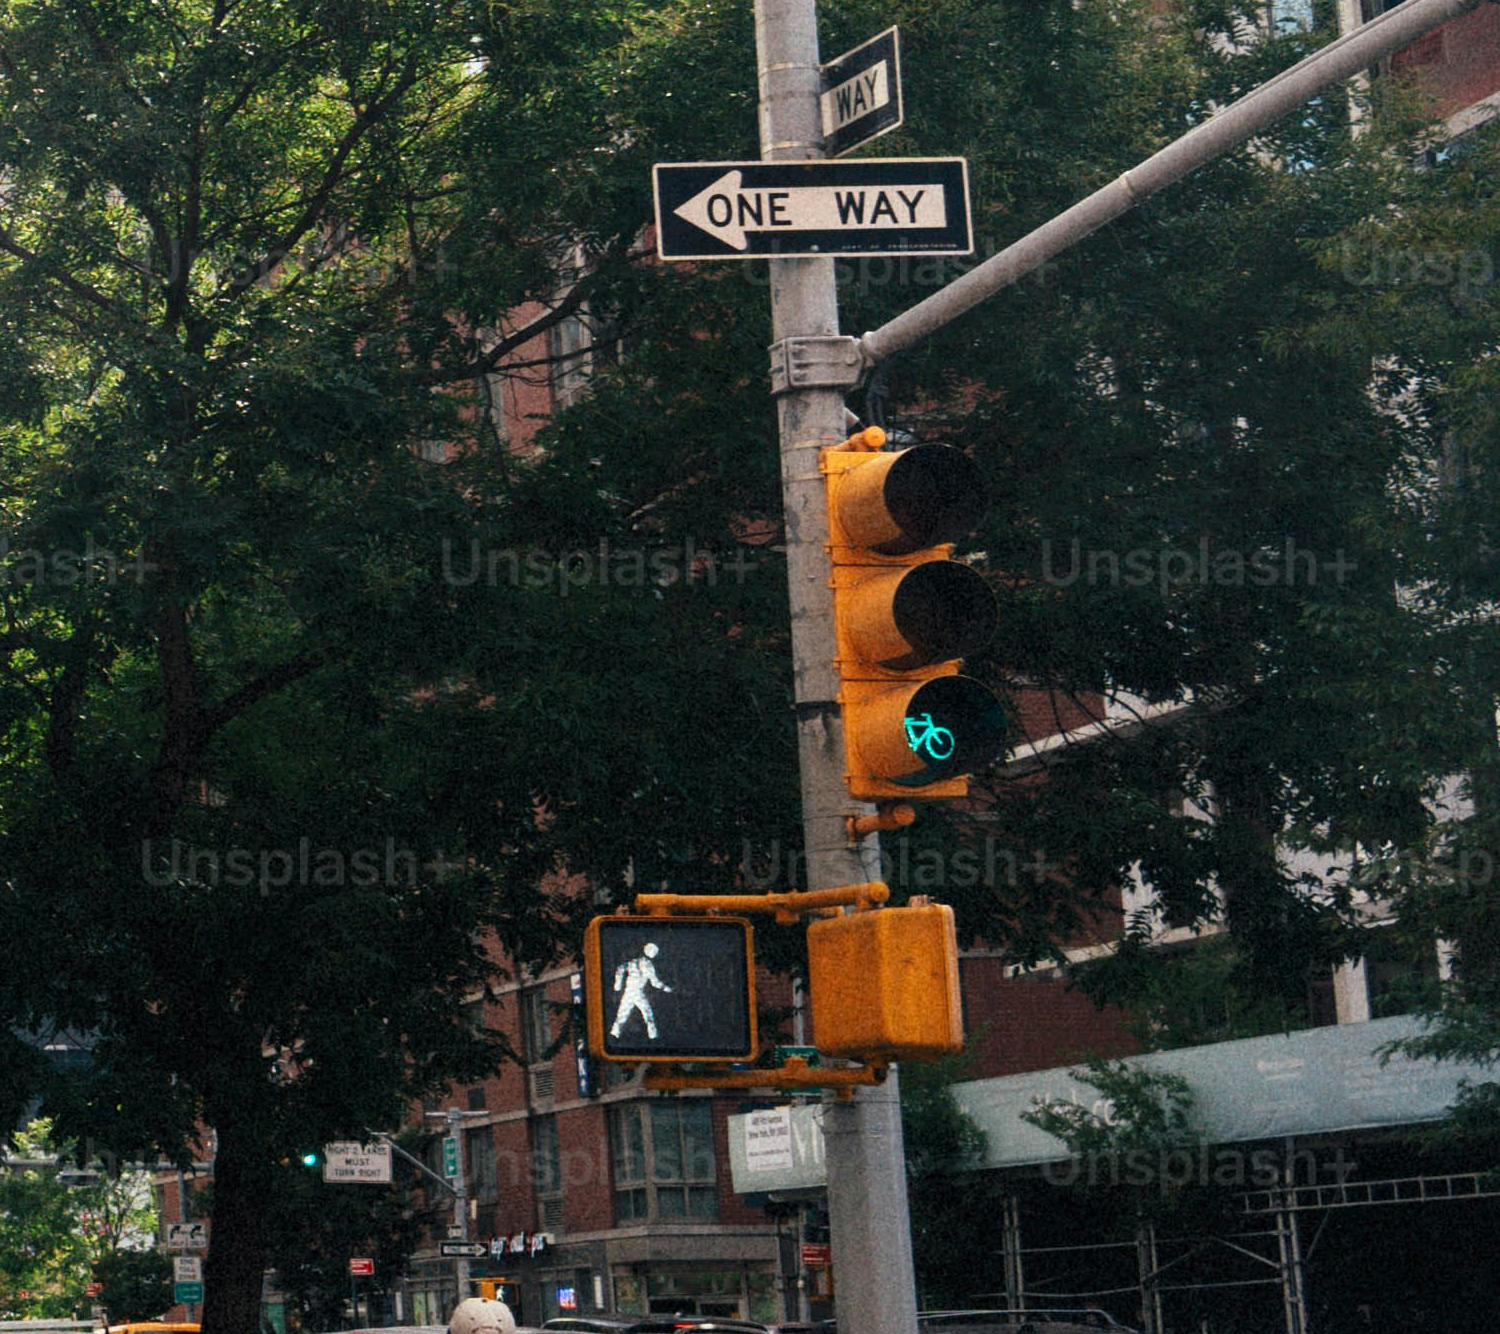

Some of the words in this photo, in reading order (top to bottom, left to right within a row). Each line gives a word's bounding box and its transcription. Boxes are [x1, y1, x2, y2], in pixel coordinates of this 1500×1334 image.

[836, 69, 878, 124] WAY
[707, 192, 792, 227] ONE
[835, 190, 925, 225] WAY
